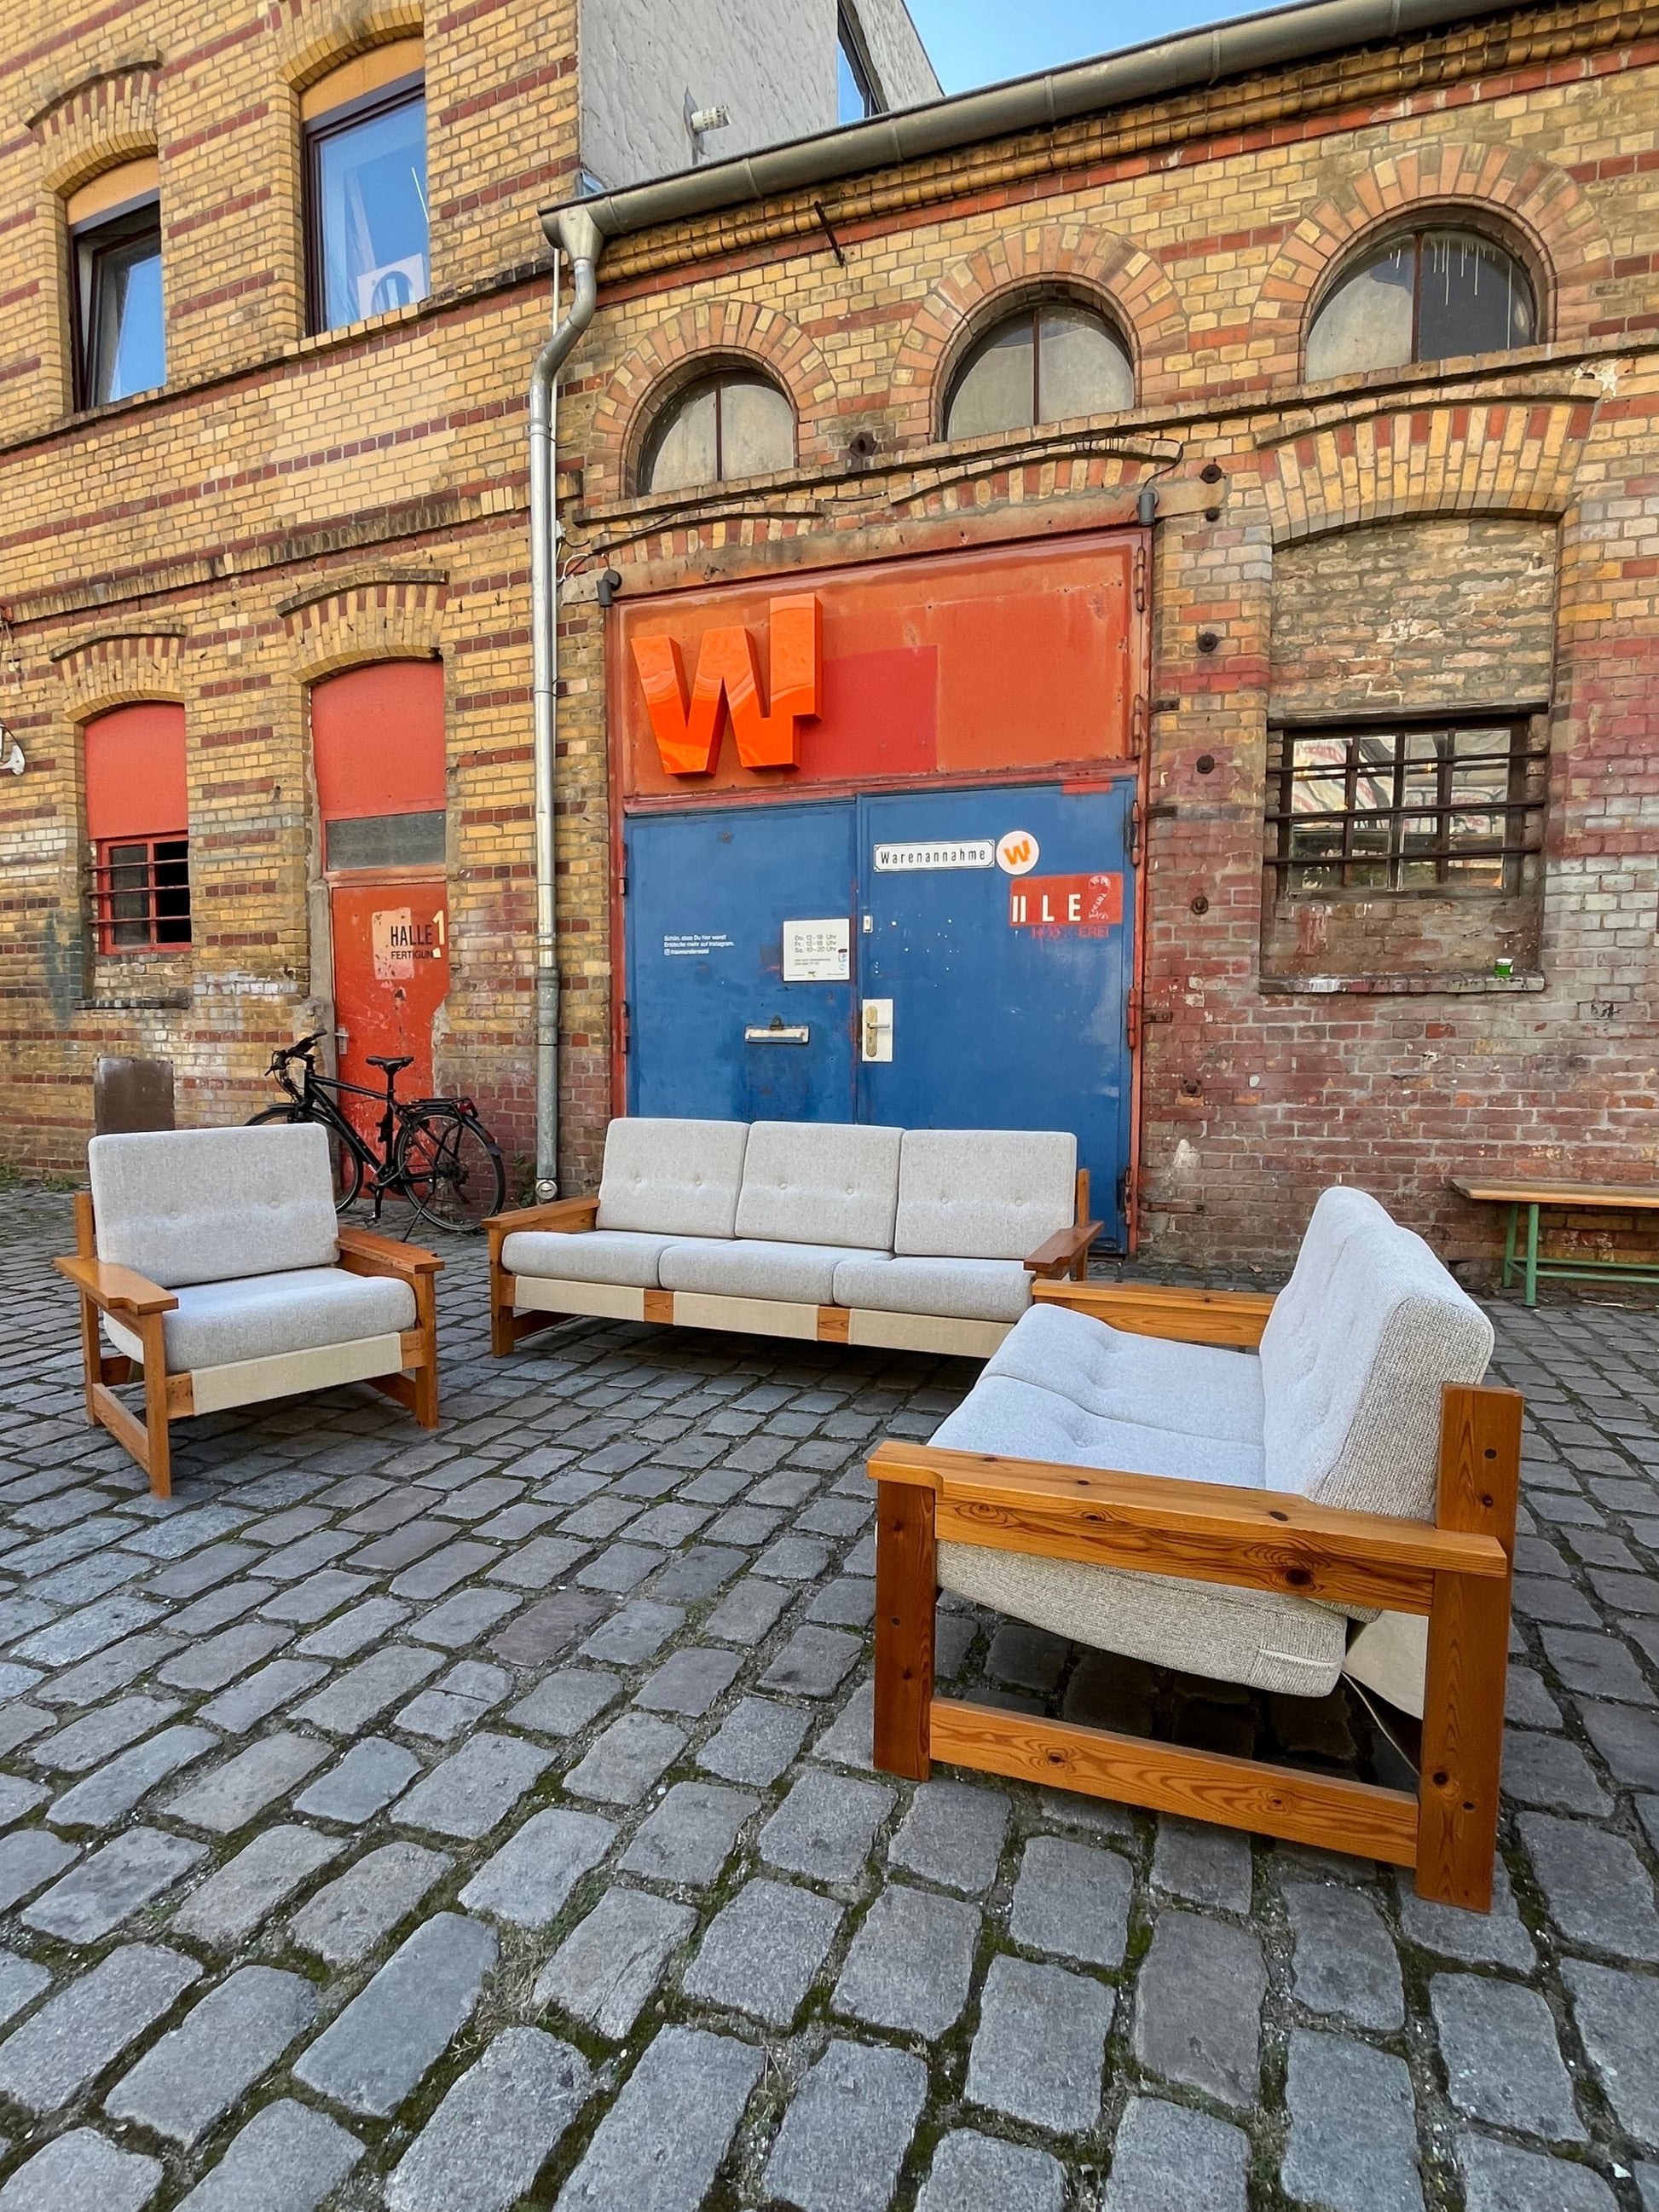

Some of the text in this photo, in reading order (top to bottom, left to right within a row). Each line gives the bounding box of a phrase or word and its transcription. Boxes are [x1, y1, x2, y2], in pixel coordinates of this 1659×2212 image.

[881, 848, 986, 864] Warenannahme
[390, 910, 445, 947] HALLE 1
[390, 950, 434, 959] FERTIGUN
